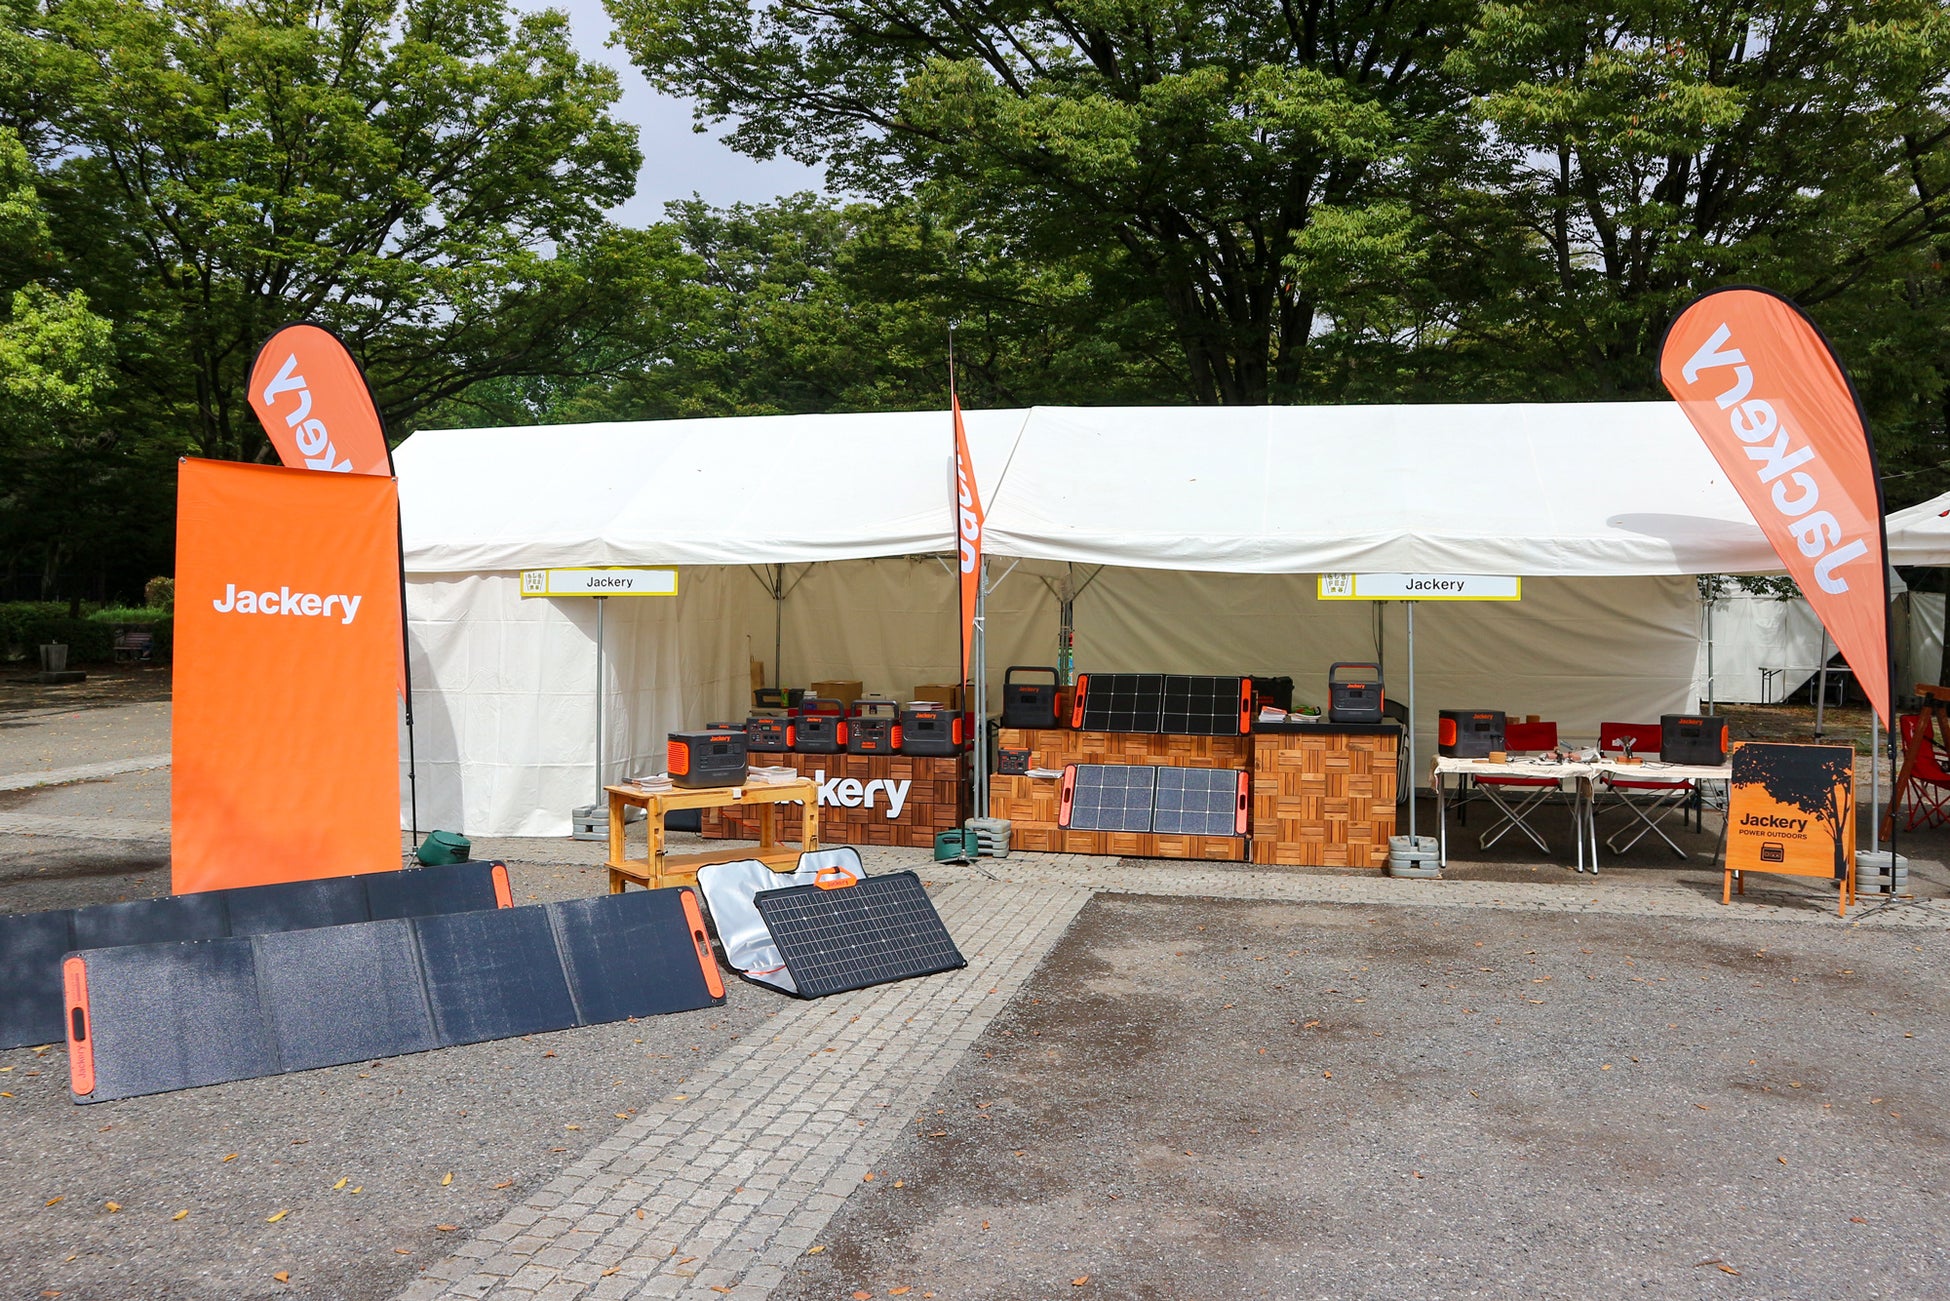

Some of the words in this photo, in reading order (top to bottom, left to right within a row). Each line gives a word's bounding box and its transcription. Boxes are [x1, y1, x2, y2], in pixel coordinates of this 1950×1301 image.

[587, 577, 633, 588] Jackery
[1405, 578, 1465, 591] Jackery
[213, 584, 362, 624] Jackery
[1740, 813, 1808, 832] Jackery
[1767, 831, 1808, 839] OUTDOORS
